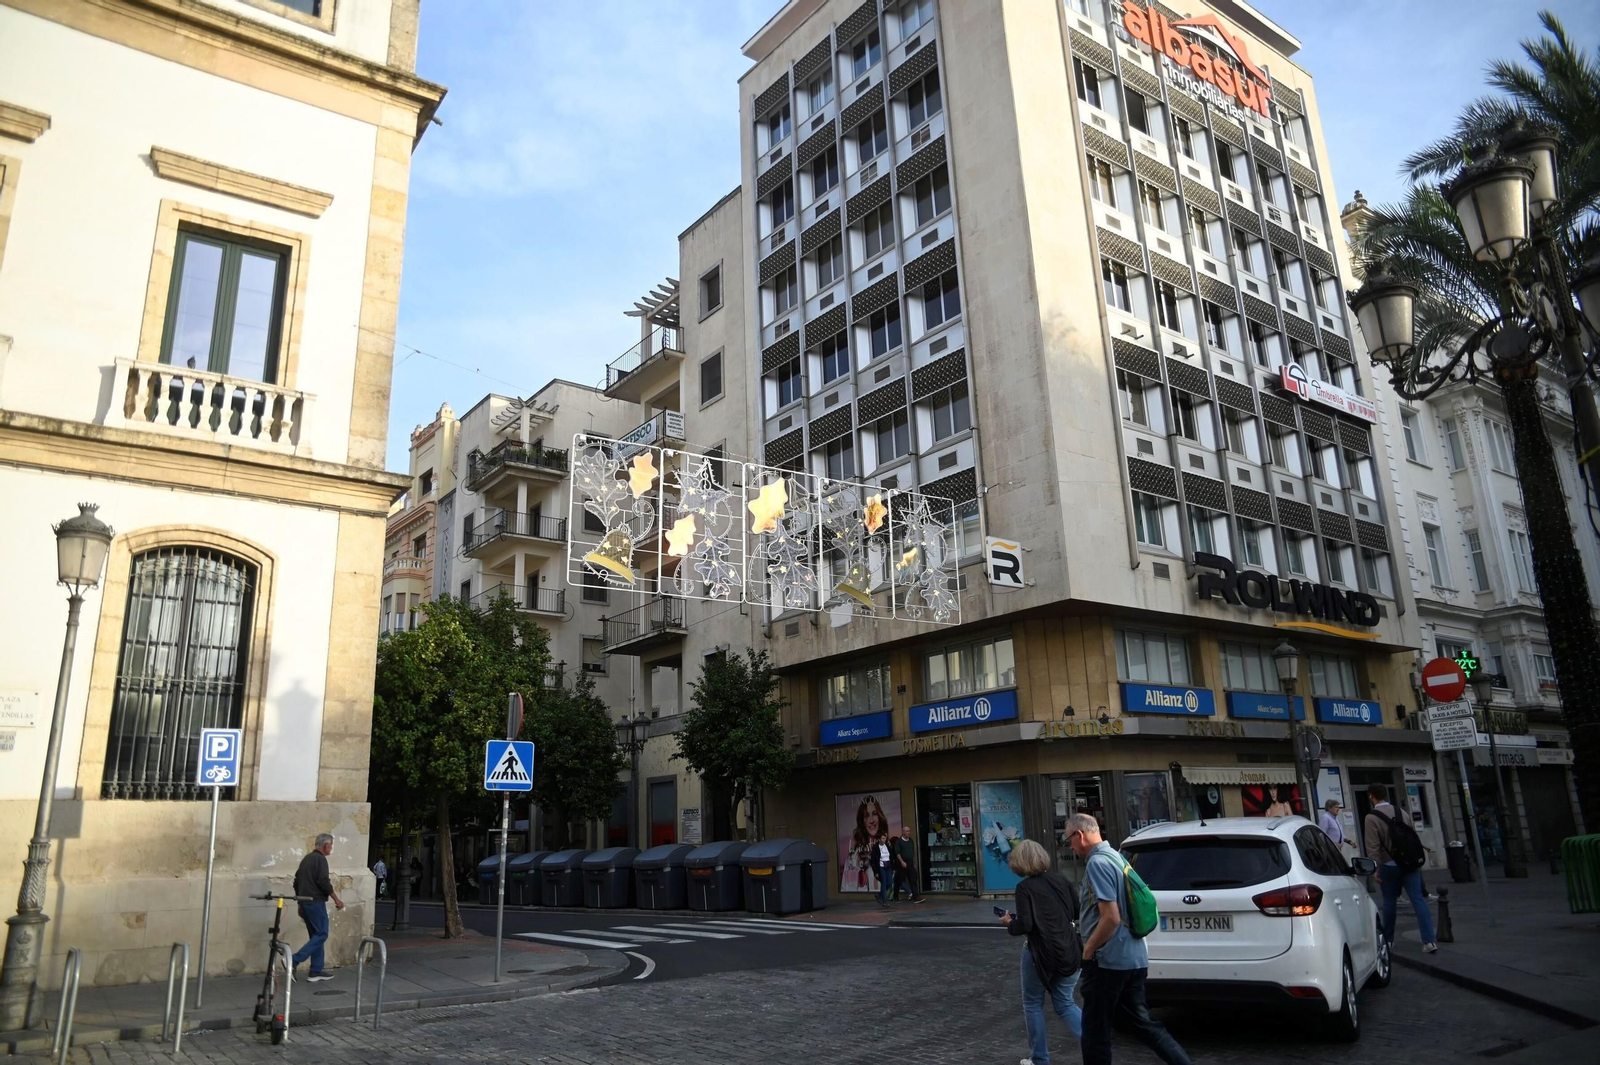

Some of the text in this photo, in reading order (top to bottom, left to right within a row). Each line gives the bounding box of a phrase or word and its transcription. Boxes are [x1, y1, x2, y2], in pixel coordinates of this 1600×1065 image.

[1122, 1, 1271, 118] albasur
[1166, 64, 1245, 122] inmobiliarias
[991, 550, 1021, 584] R
[1195, 551, 1381, 627] ROLWIND
[1145, 689, 1183, 708] Allianz
[1437, 703, 1460, 711] EXCEPTO
[928, 704, 972, 724] Allianz
[1333, 703, 1360, 719] Allianz
[837, 727, 868, 737] Allianz Seguros
[1036, 717, 1124, 740] Aromas
[211, 737, 229, 758] P
[901, 732, 965, 754] COSMETICA
[1239, 770, 1266, 782] Aromas
[1129, 818, 1167, 831] LIBR
[1169, 916, 1230, 930] 1159 KNN
